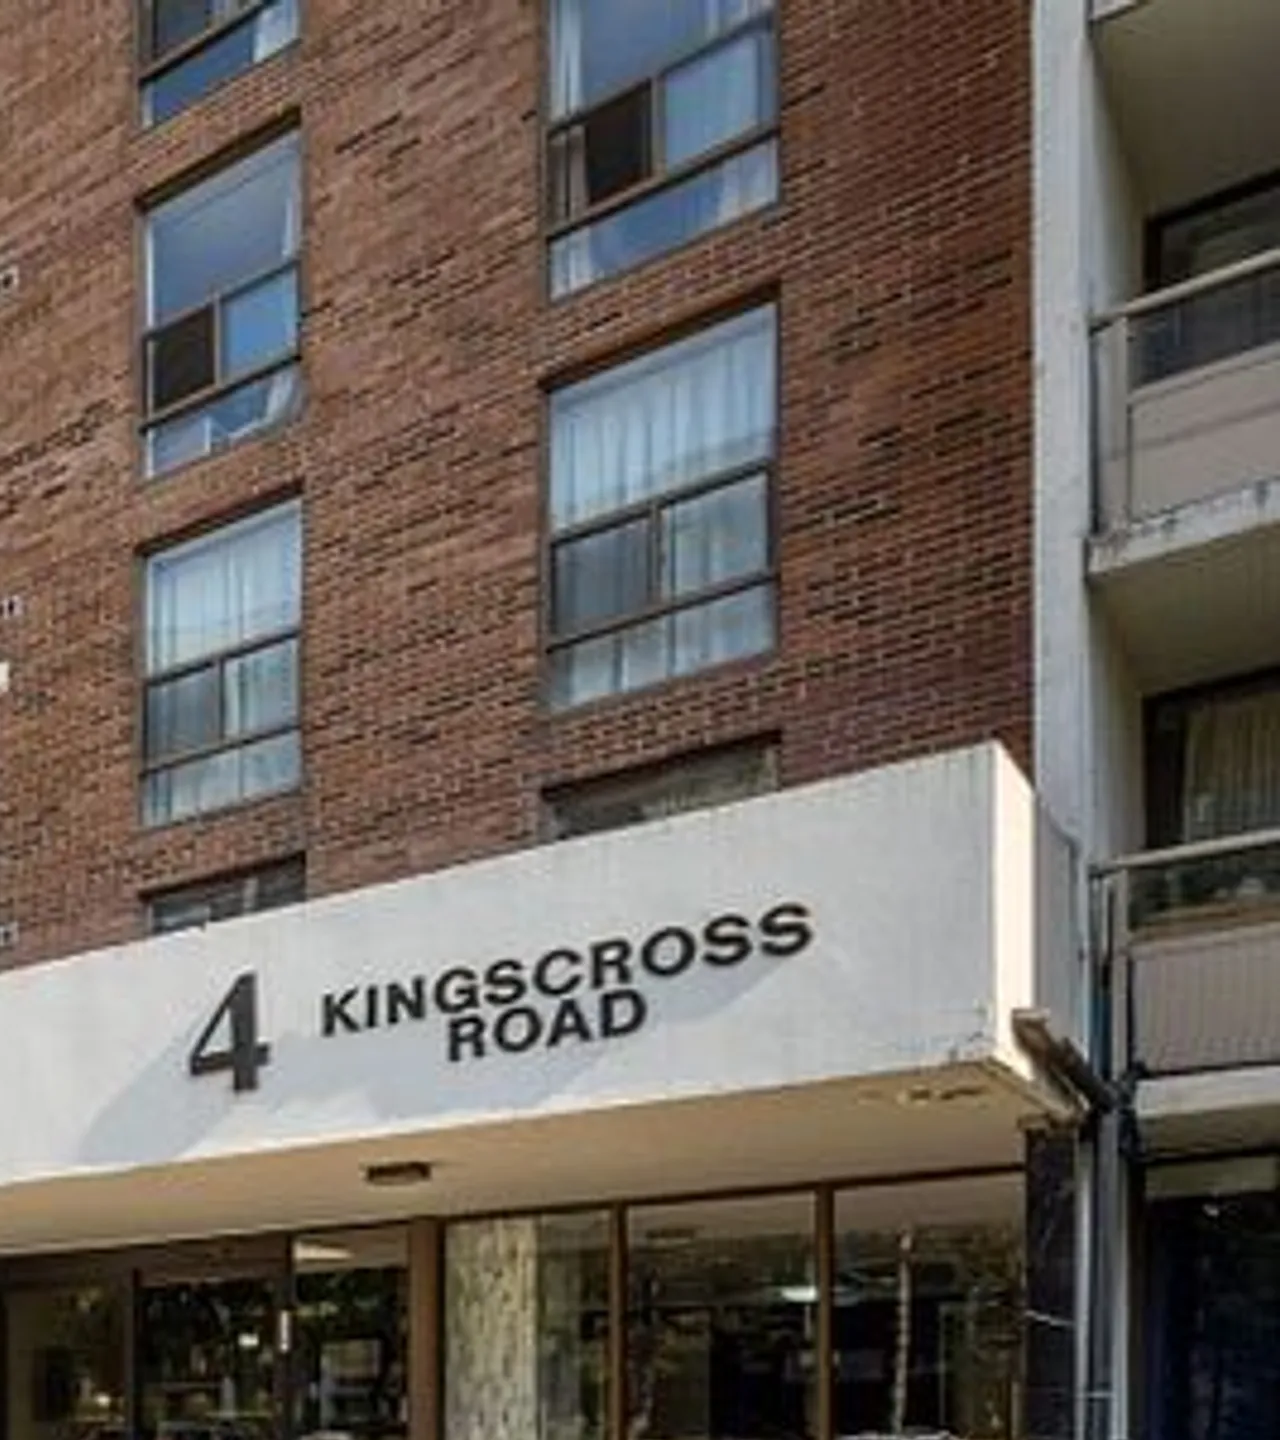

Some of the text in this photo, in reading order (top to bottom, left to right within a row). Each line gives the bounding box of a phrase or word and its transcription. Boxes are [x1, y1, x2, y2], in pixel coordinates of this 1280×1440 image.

[321, 902, 813, 1037] KINGSCROSS
[448, 988, 648, 1062] ROAD
[188, 971, 271, 1092] 4
